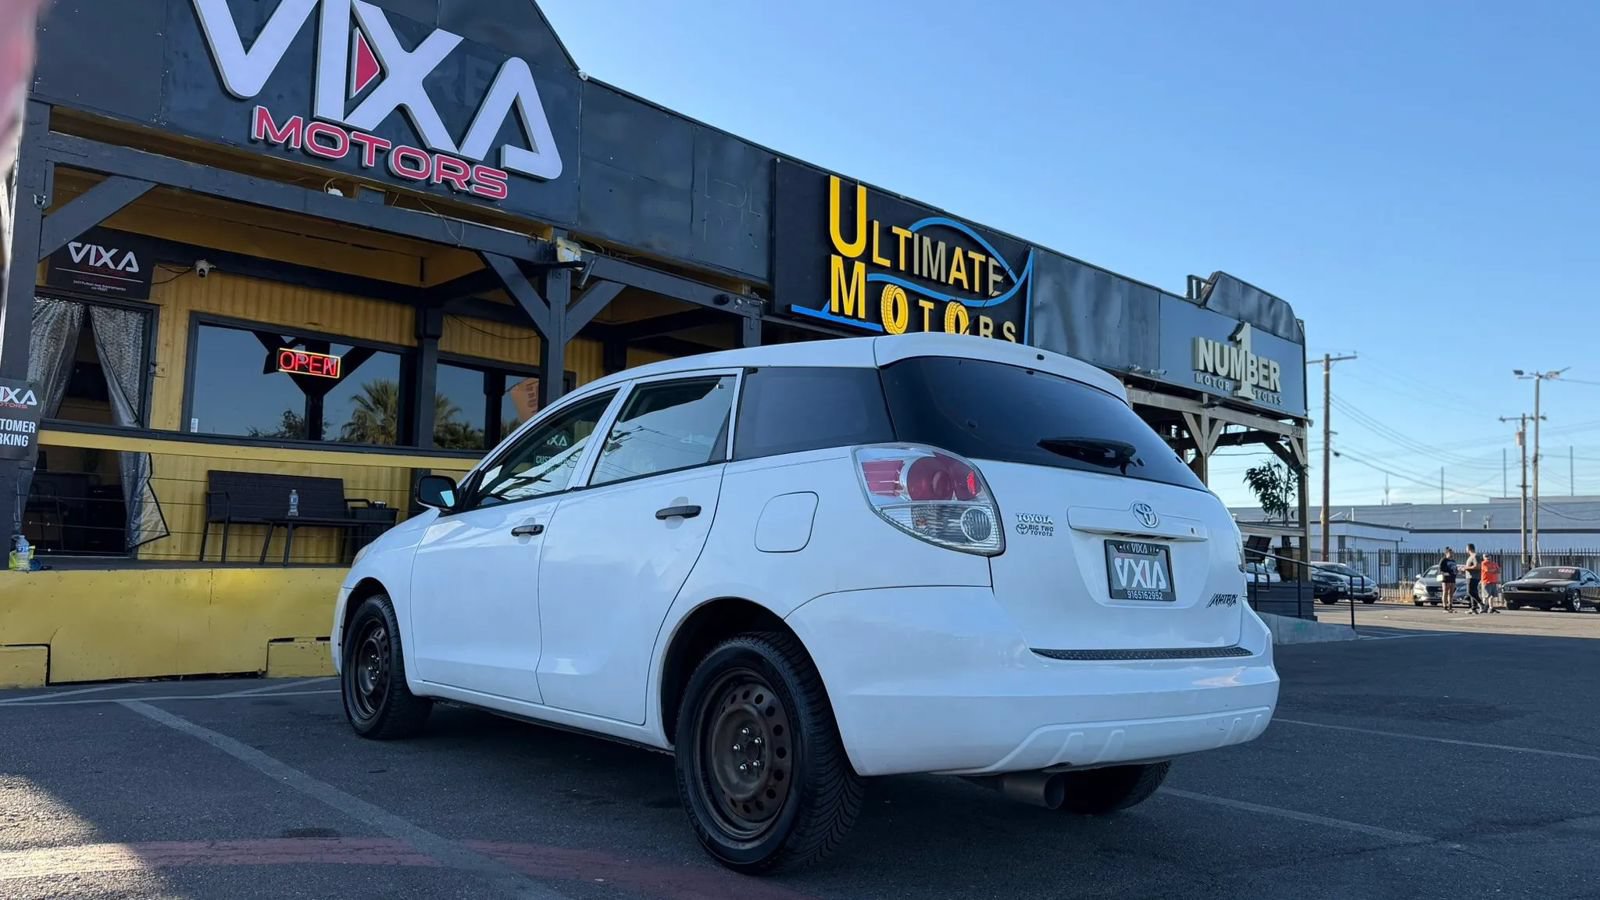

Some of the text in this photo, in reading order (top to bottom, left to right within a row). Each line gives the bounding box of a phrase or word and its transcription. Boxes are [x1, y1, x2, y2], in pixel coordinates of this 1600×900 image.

[192, 0, 562, 180] VIXA
[251, 105, 508, 199] MOTORS
[830, 175, 1003, 297] ULTIMATE
[67, 241, 140, 273] VIXA
[280, 351, 337, 376] OPEN
[1194, 336, 1280, 392] NUMBER
[0, 386, 37, 405] IXA
[0, 418, 36, 433] TOMER
[0, 432, 29, 447] KING
[1016, 513, 1053, 525] TOYOTA
